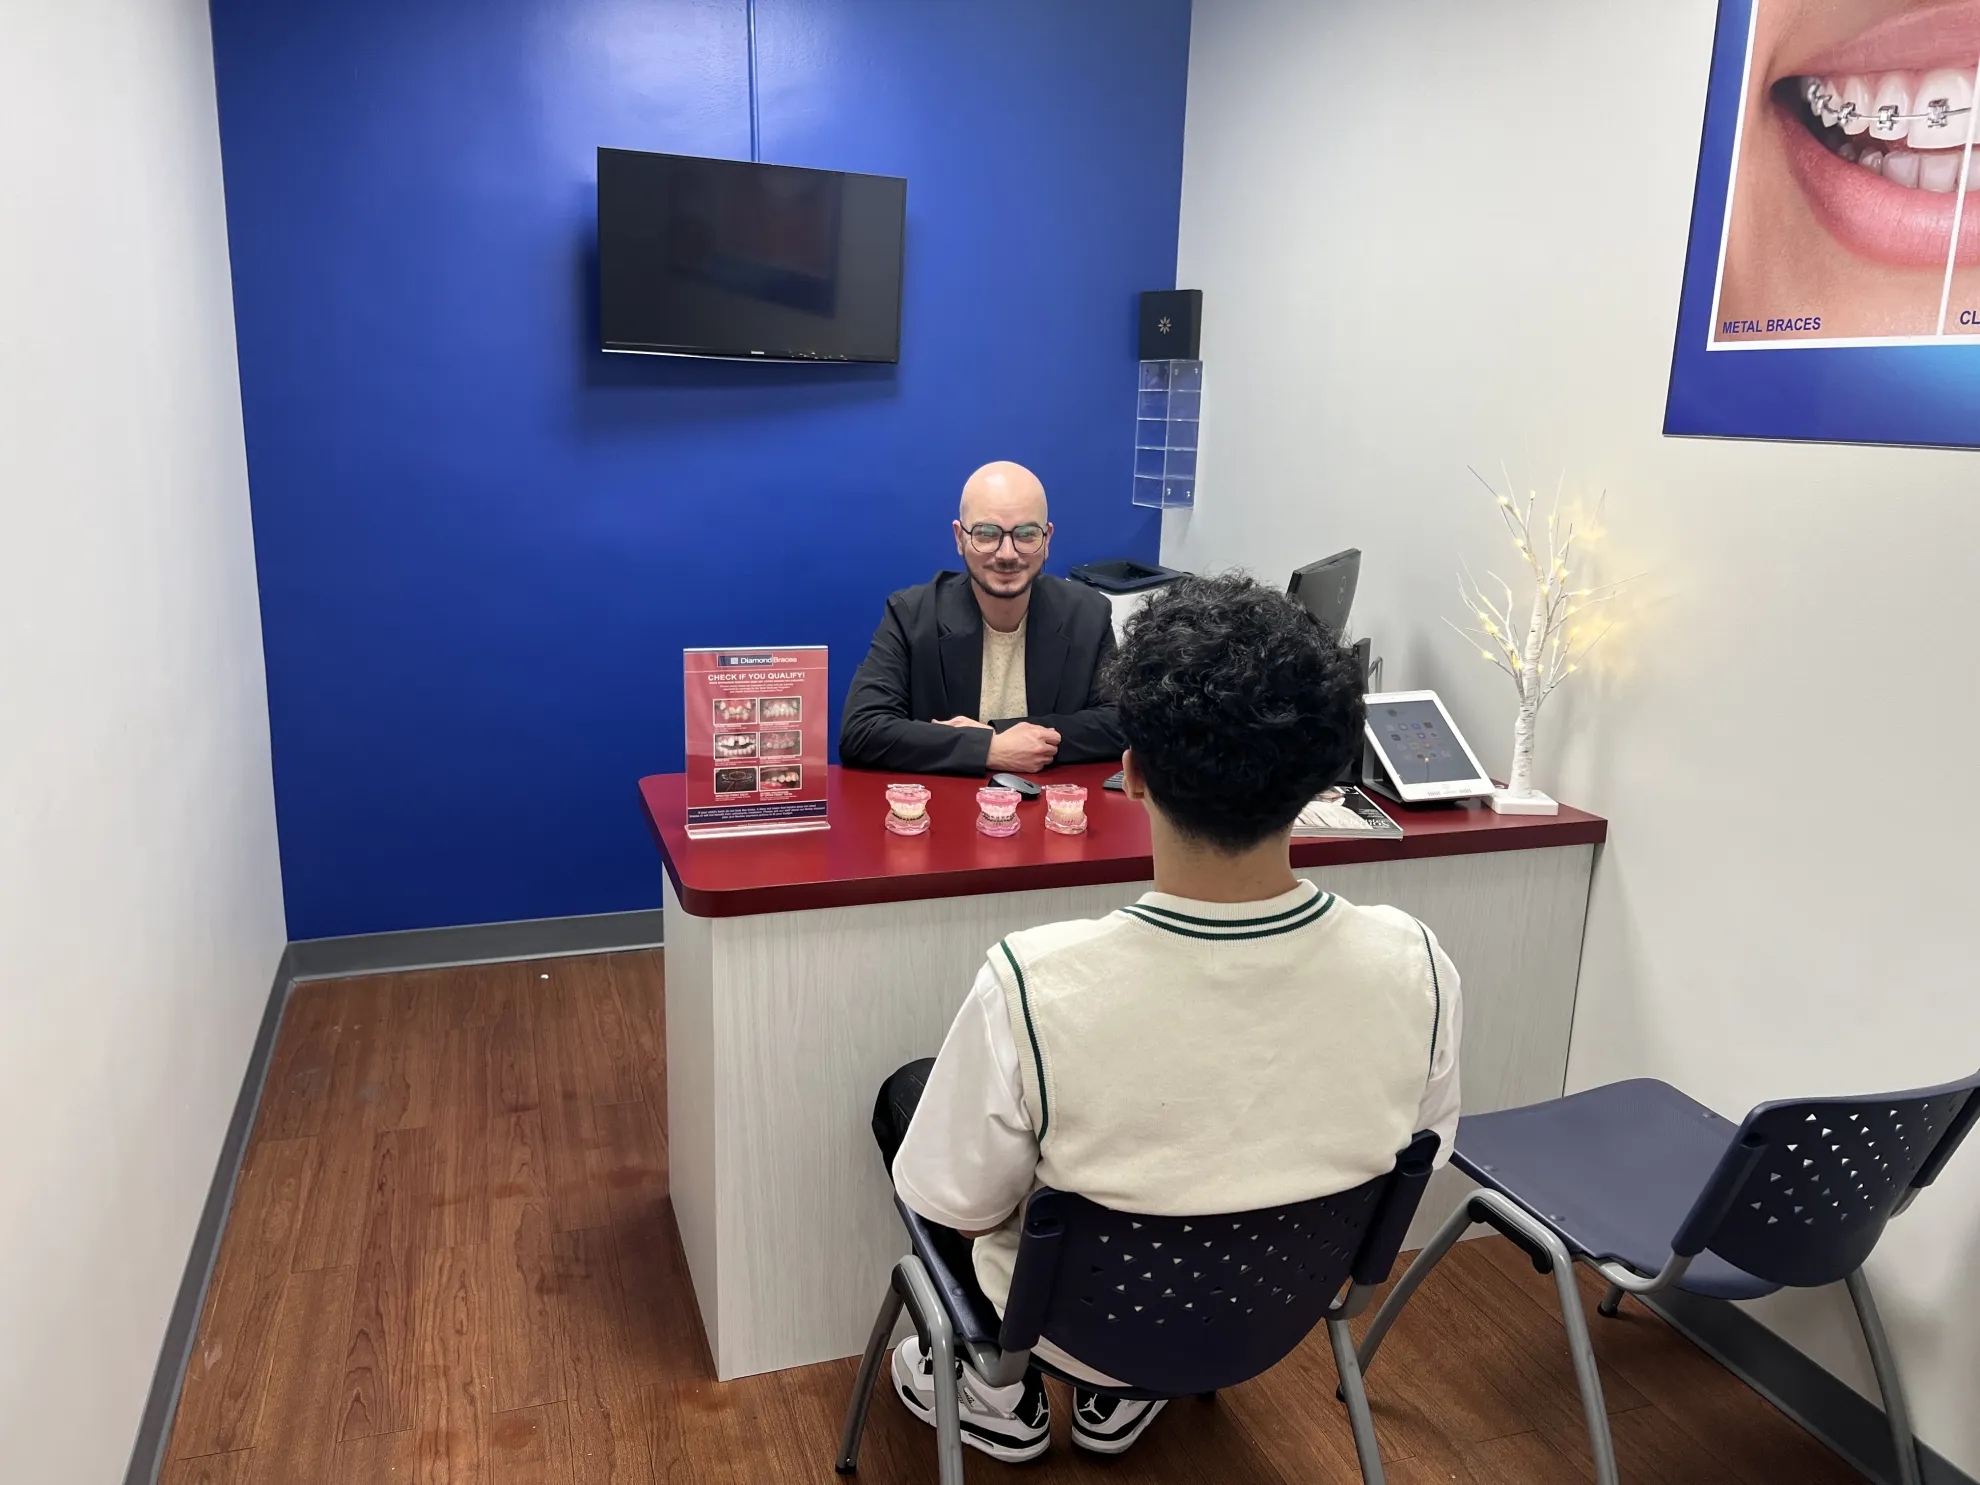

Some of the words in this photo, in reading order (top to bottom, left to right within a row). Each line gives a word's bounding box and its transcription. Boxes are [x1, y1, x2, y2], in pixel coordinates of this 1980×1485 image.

[1722, 320, 1762, 334] METAL
[1766, 317, 1821, 332] BRACES
[708, 673, 738, 681] CHECK
[748, 672, 766, 680] YOU
[767, 671, 805, 680] QUALIFY!
